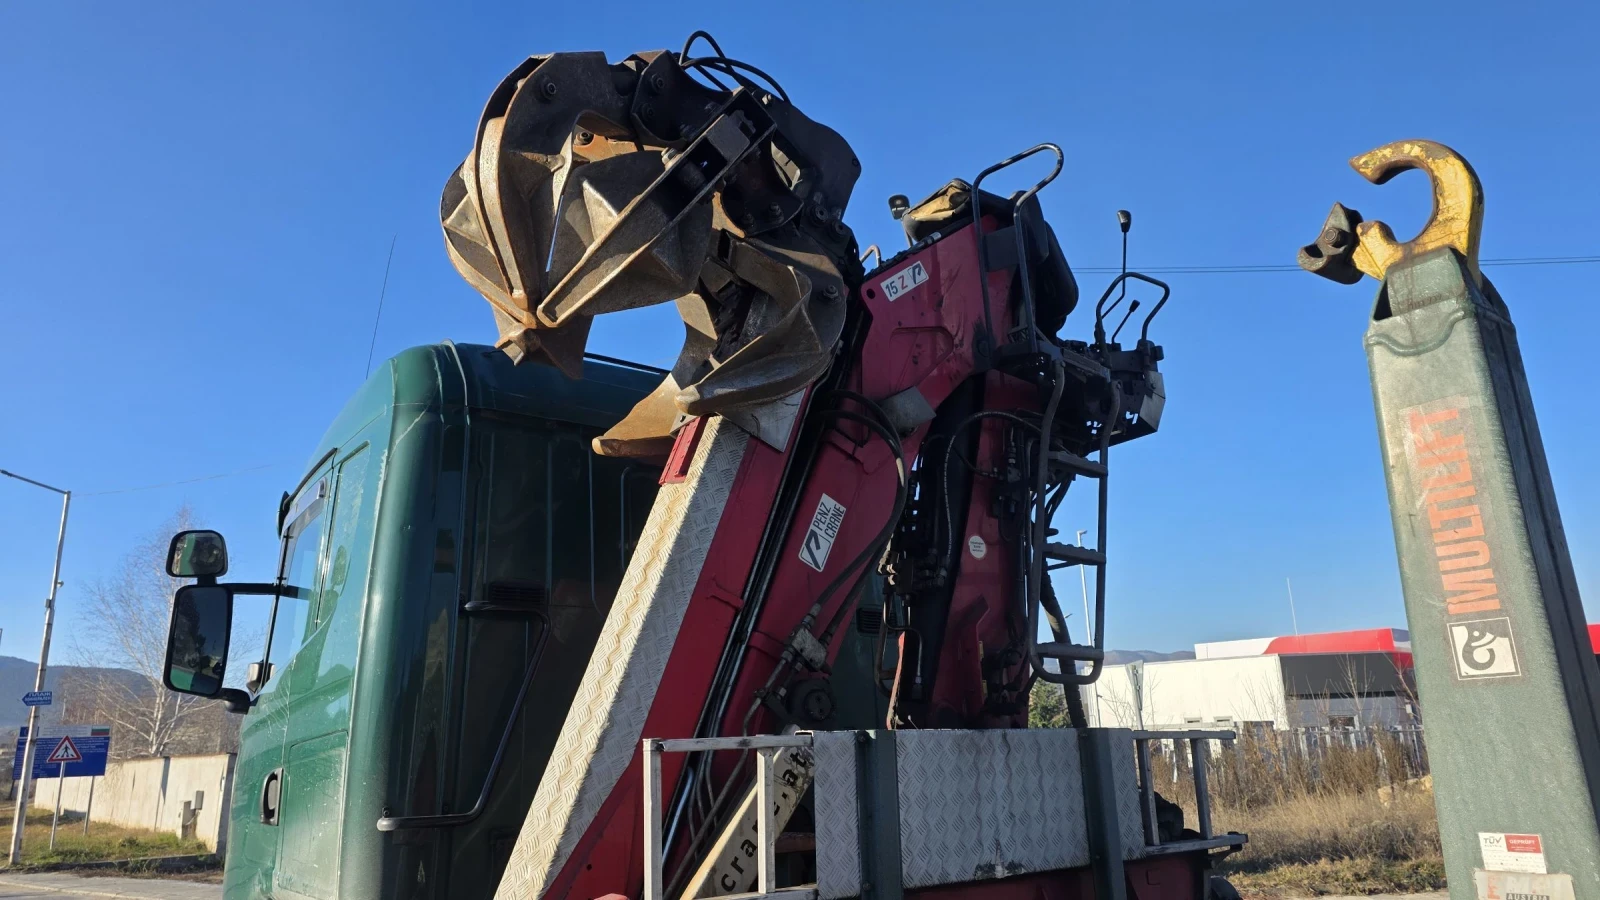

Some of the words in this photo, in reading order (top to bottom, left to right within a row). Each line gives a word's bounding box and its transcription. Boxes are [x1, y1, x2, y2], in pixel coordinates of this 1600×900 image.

[885, 280, 898, 298] 15
[898, 274, 908, 291] Z
[813, 501, 832, 531] PENZ
[824, 503, 845, 539] CRANE
[1408, 407, 1501, 615] MULTILIFT
